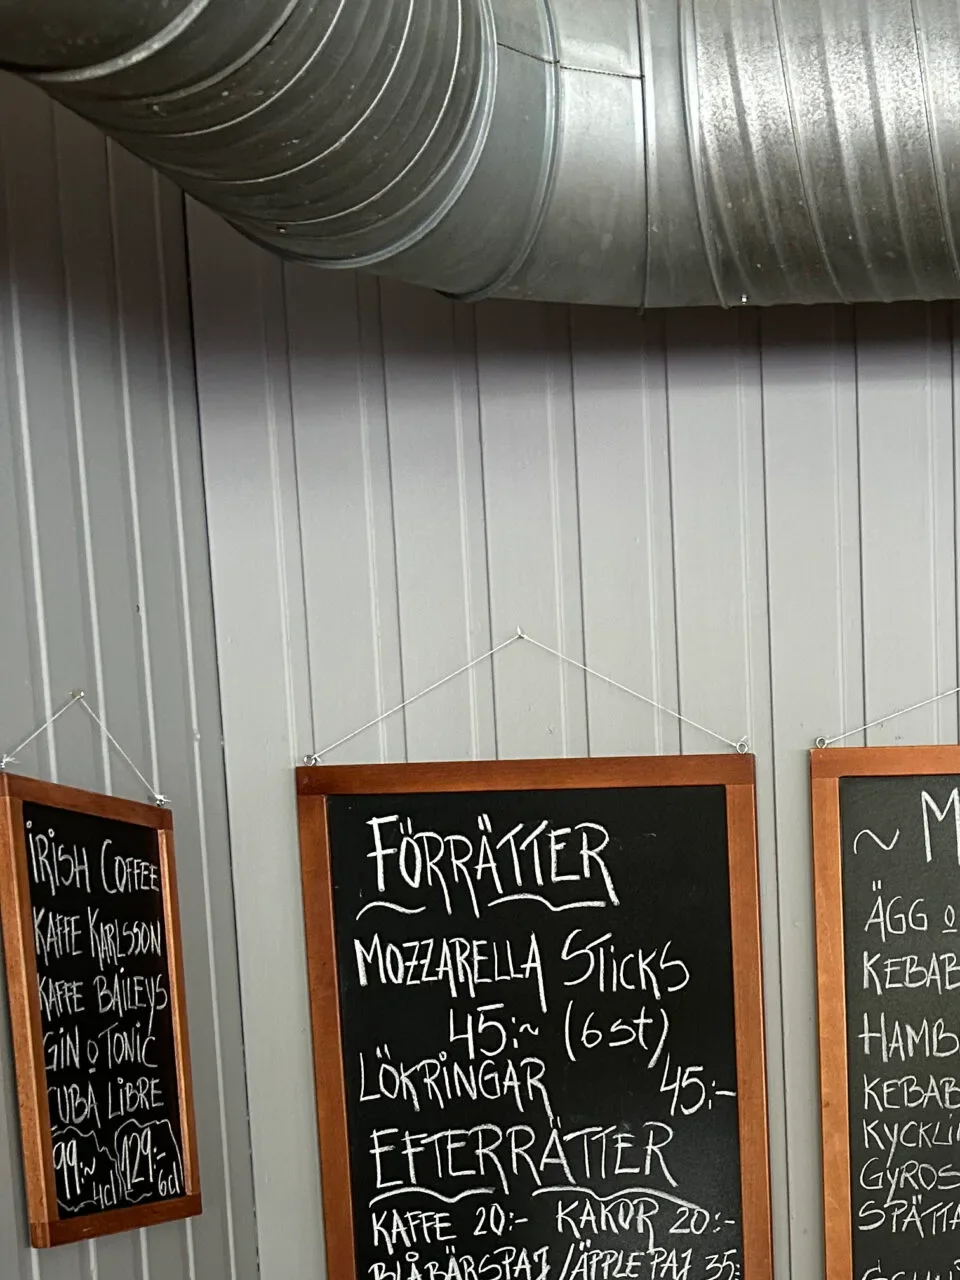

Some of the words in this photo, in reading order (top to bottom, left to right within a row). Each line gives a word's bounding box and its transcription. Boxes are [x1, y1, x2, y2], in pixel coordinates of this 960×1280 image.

[101, 839, 160, 893] COFFEE
[366, 813, 620, 918] FÖRRÄTTER
[33, 906, 83, 966] KAFFE
[87, 906, 161, 969] KARLSSON
[864, 879, 929, 942] ÄGG
[36, 976, 83, 1021] KAFFE
[354, 932, 547, 1012] MOZZARELLA
[359, 1043, 554, 1123] LÖKRINGAR
[660, 1051, 737, 1116] 45:-
[369, 1117, 678, 1195] EFTERRÄTTER
[372, 1209, 457, 1255] KAFFE
[473, 1203, 528, 1235] 20:-
[556, 1198, 659, 1254] KAKOR
